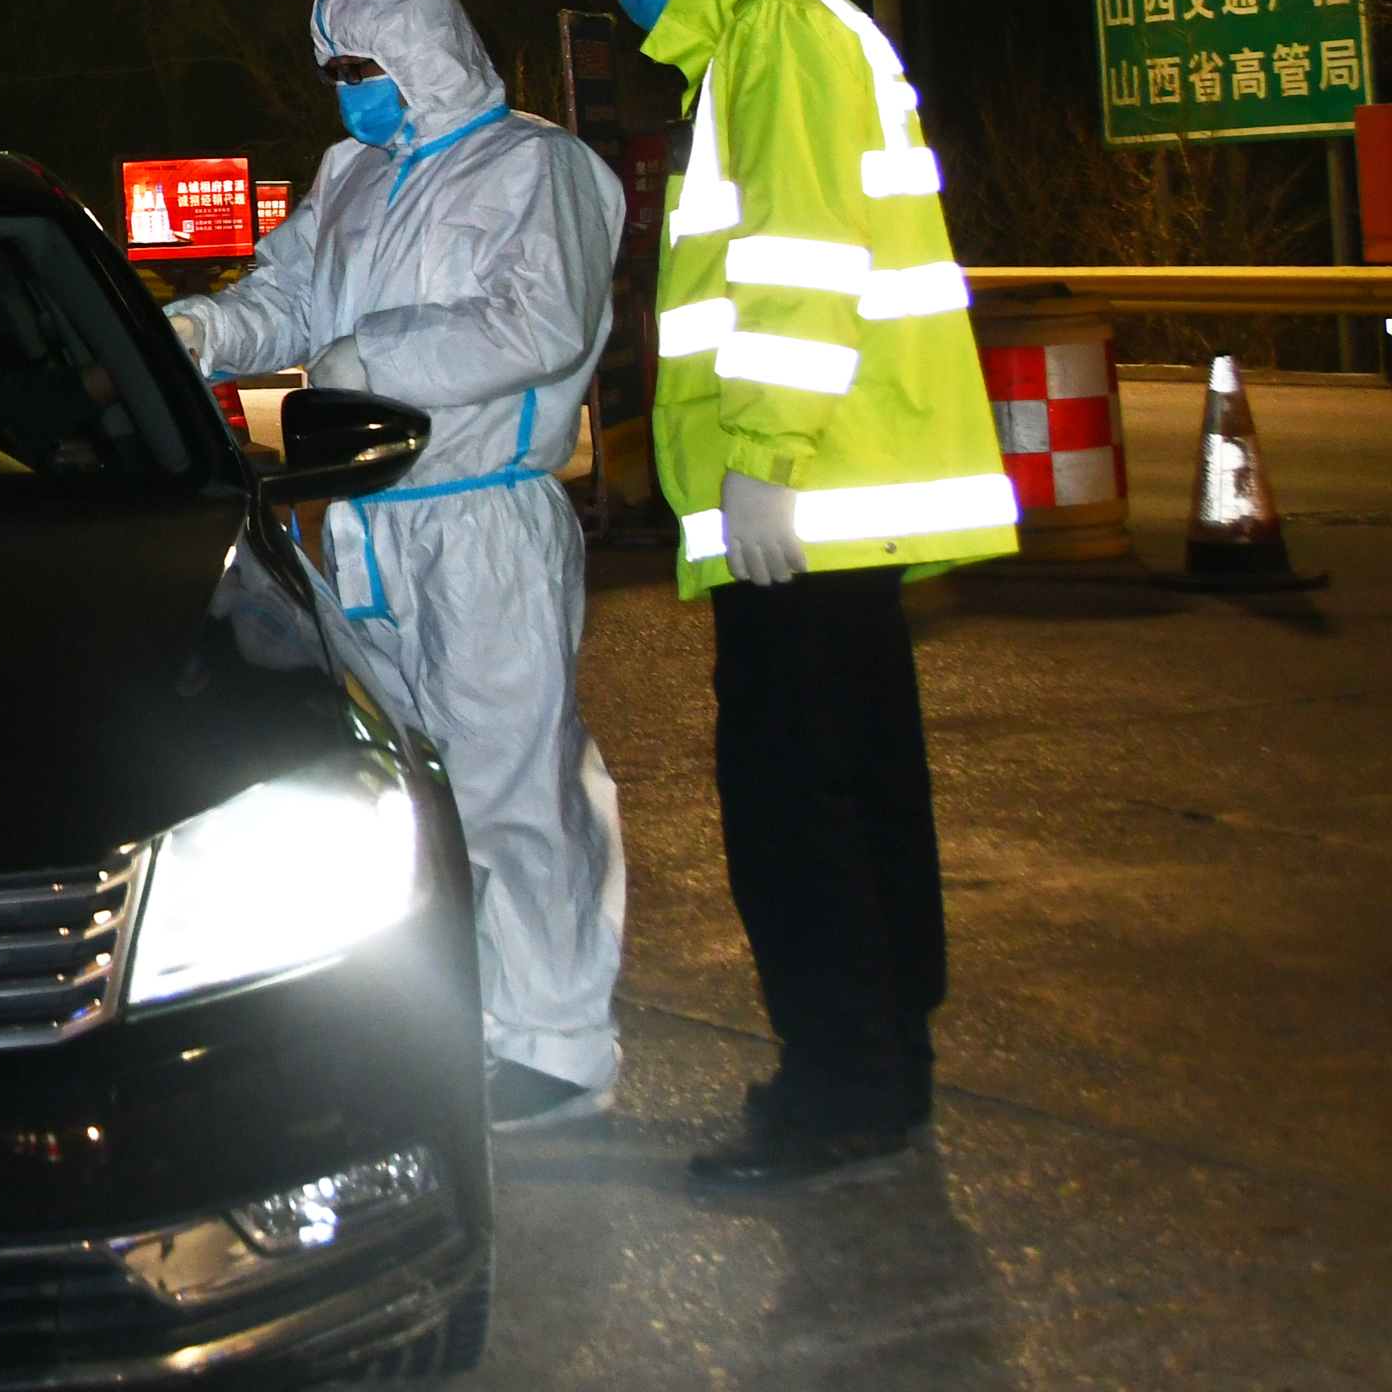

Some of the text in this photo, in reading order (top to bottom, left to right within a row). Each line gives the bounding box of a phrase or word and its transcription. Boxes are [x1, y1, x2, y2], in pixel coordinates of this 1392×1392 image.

[1109, 38, 1361, 107] 山西省高管局
